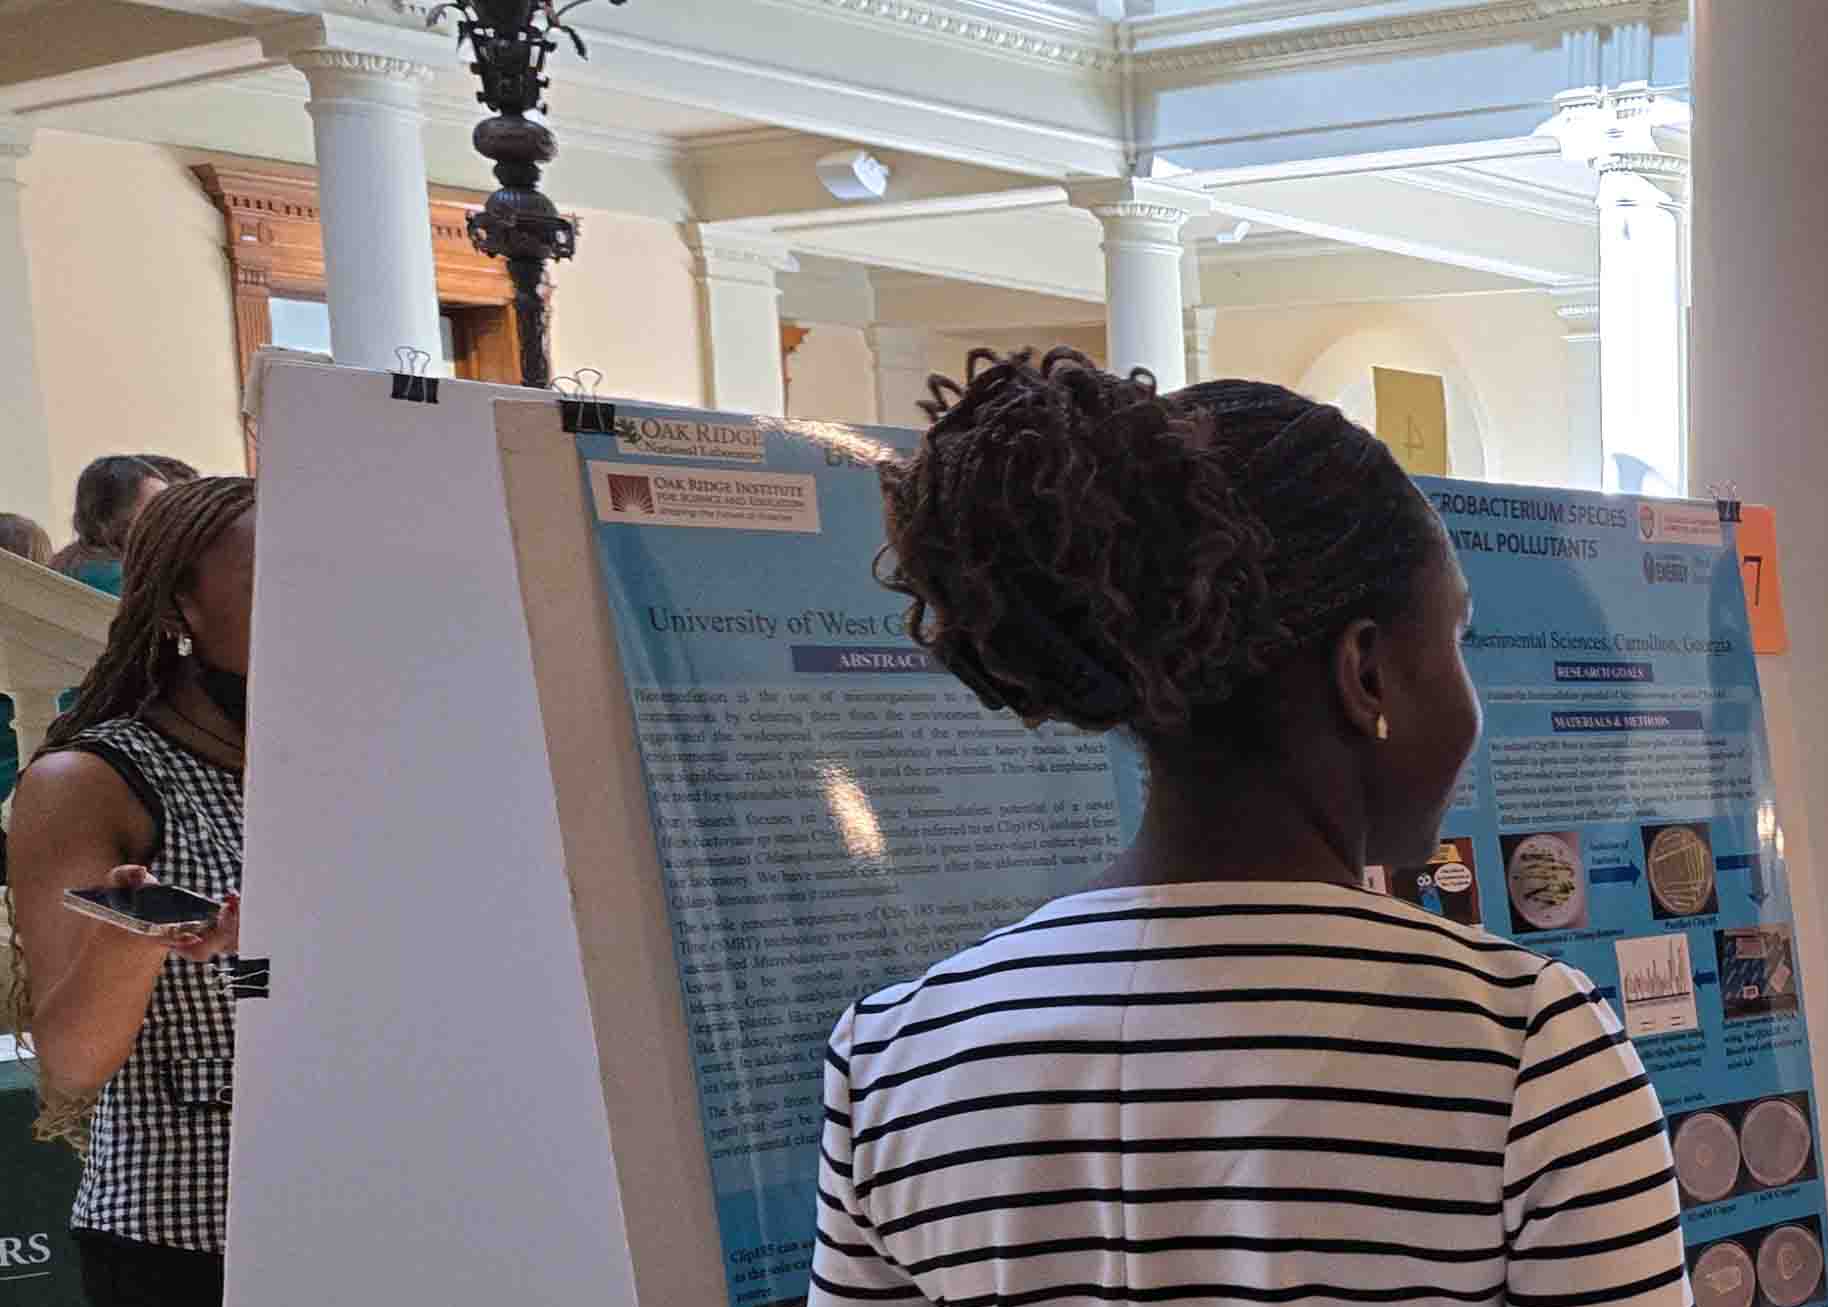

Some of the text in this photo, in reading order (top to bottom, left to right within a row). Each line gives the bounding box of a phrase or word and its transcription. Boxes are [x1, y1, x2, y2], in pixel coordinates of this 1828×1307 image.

[640, 417, 763, 446] OAK RIDGE
[654, 477, 806, 499] OAK RIDGE INSTITUTE
[1568, 504, 1628, 530] SPECIES
[1496, 532, 1600, 561] POLLUTANTS
[1742, 554, 1764, 608] 7
[649, 606, 777, 640] University
[784, 609, 813, 635] of
[812, 609, 882, 638] West
